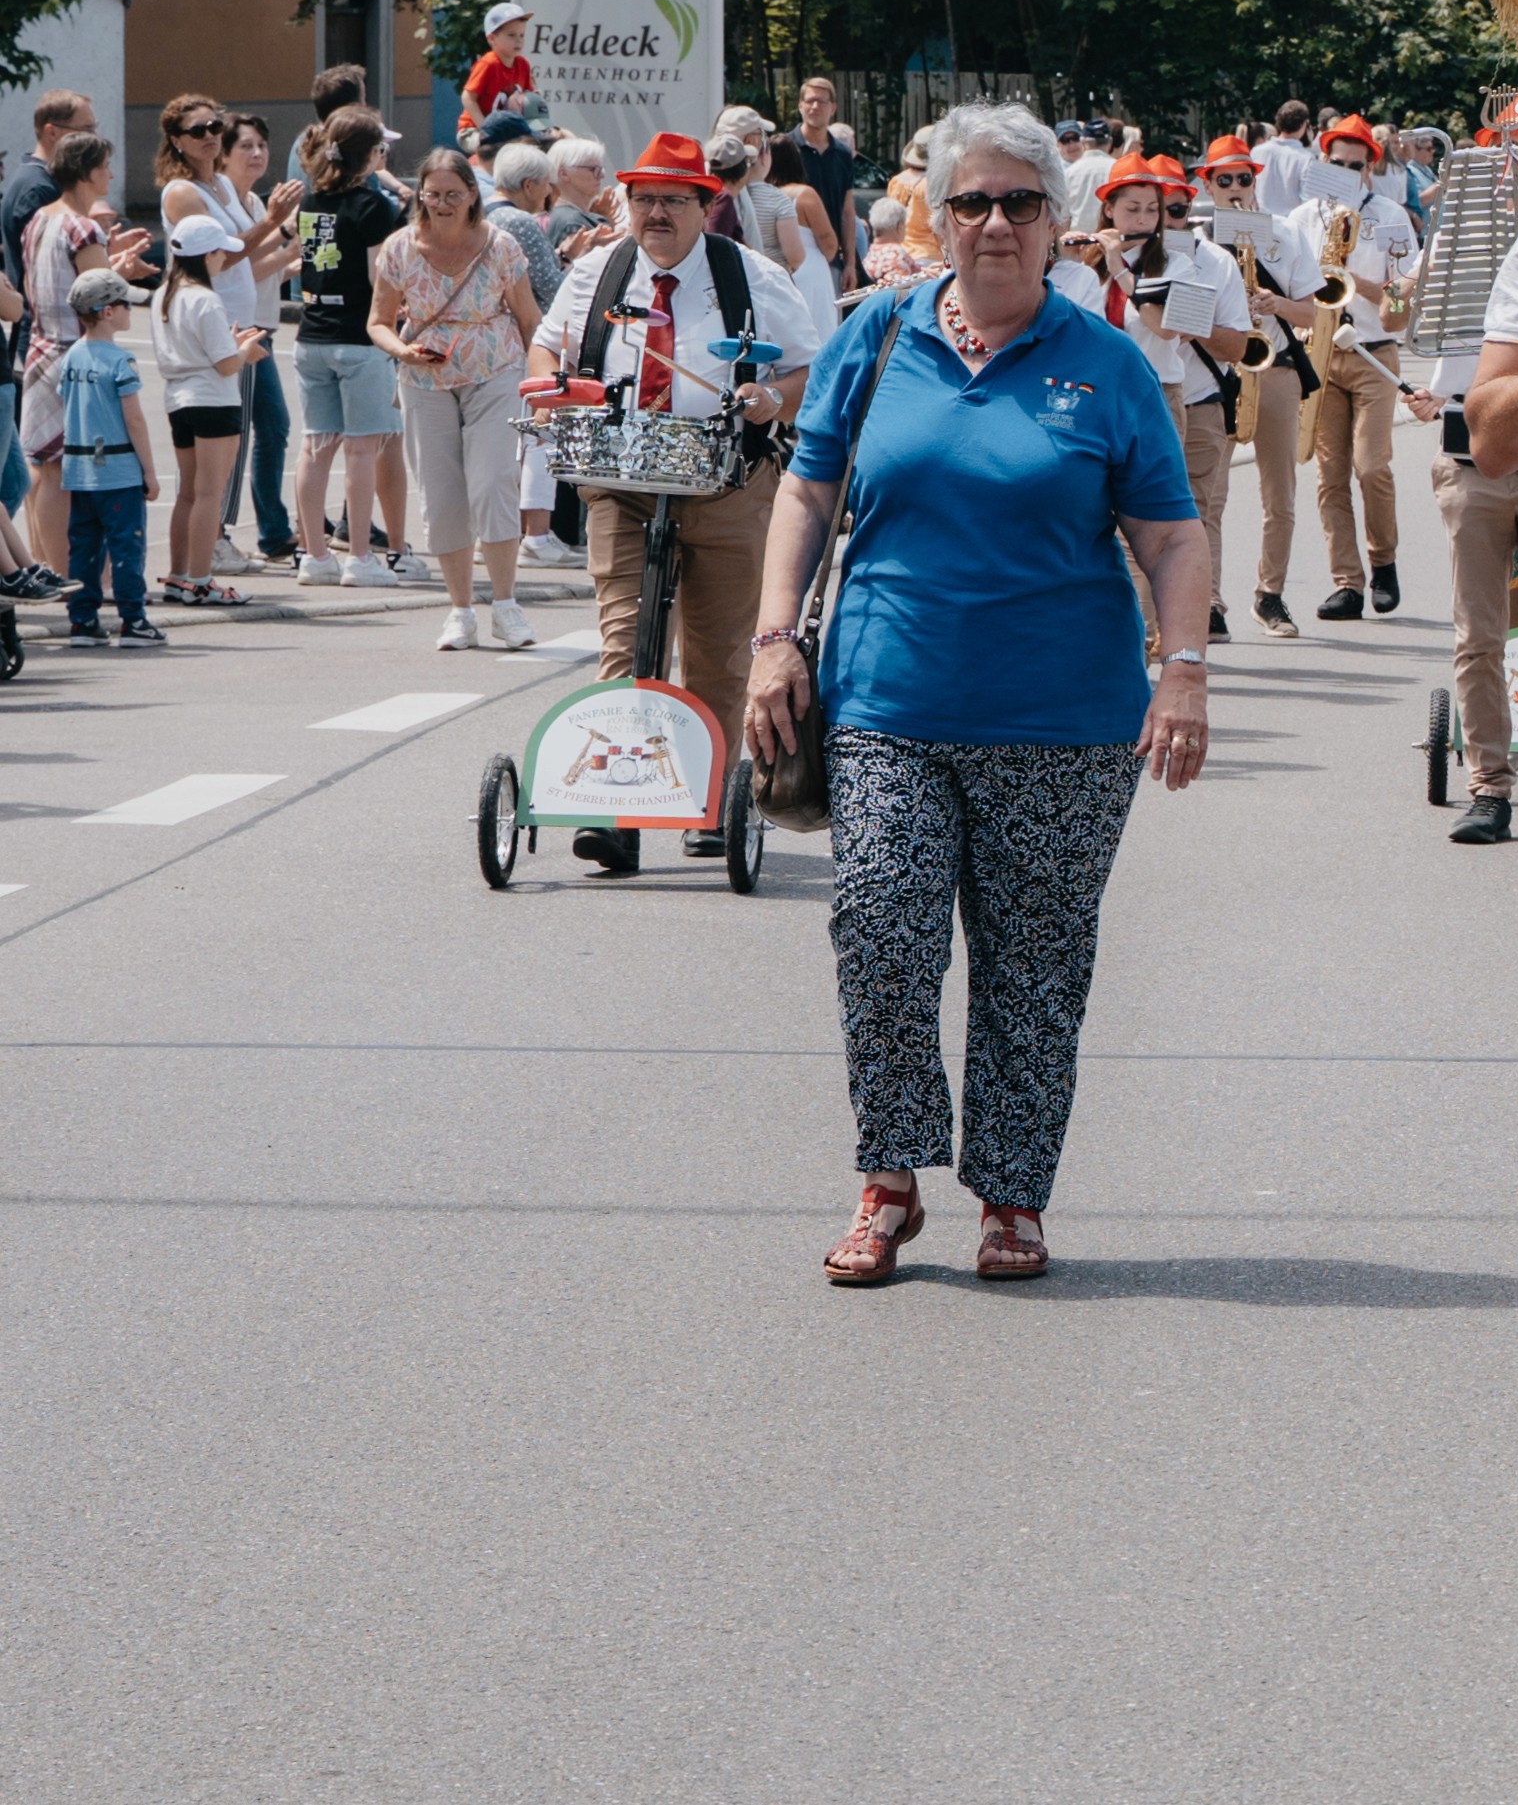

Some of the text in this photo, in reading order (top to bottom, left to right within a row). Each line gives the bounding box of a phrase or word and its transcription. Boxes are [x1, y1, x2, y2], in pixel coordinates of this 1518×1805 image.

[530, 23, 660, 58] Feldeck
[531, 65, 683, 83] GARTENHOTEL
[541, 90, 665, 106] ESTAURANT
[567, 706, 623, 724] FANFARE
[644, 708, 690, 727] CLIQUE
[545, 787, 694, 806] ST PIERRE DE CHANDIEU
